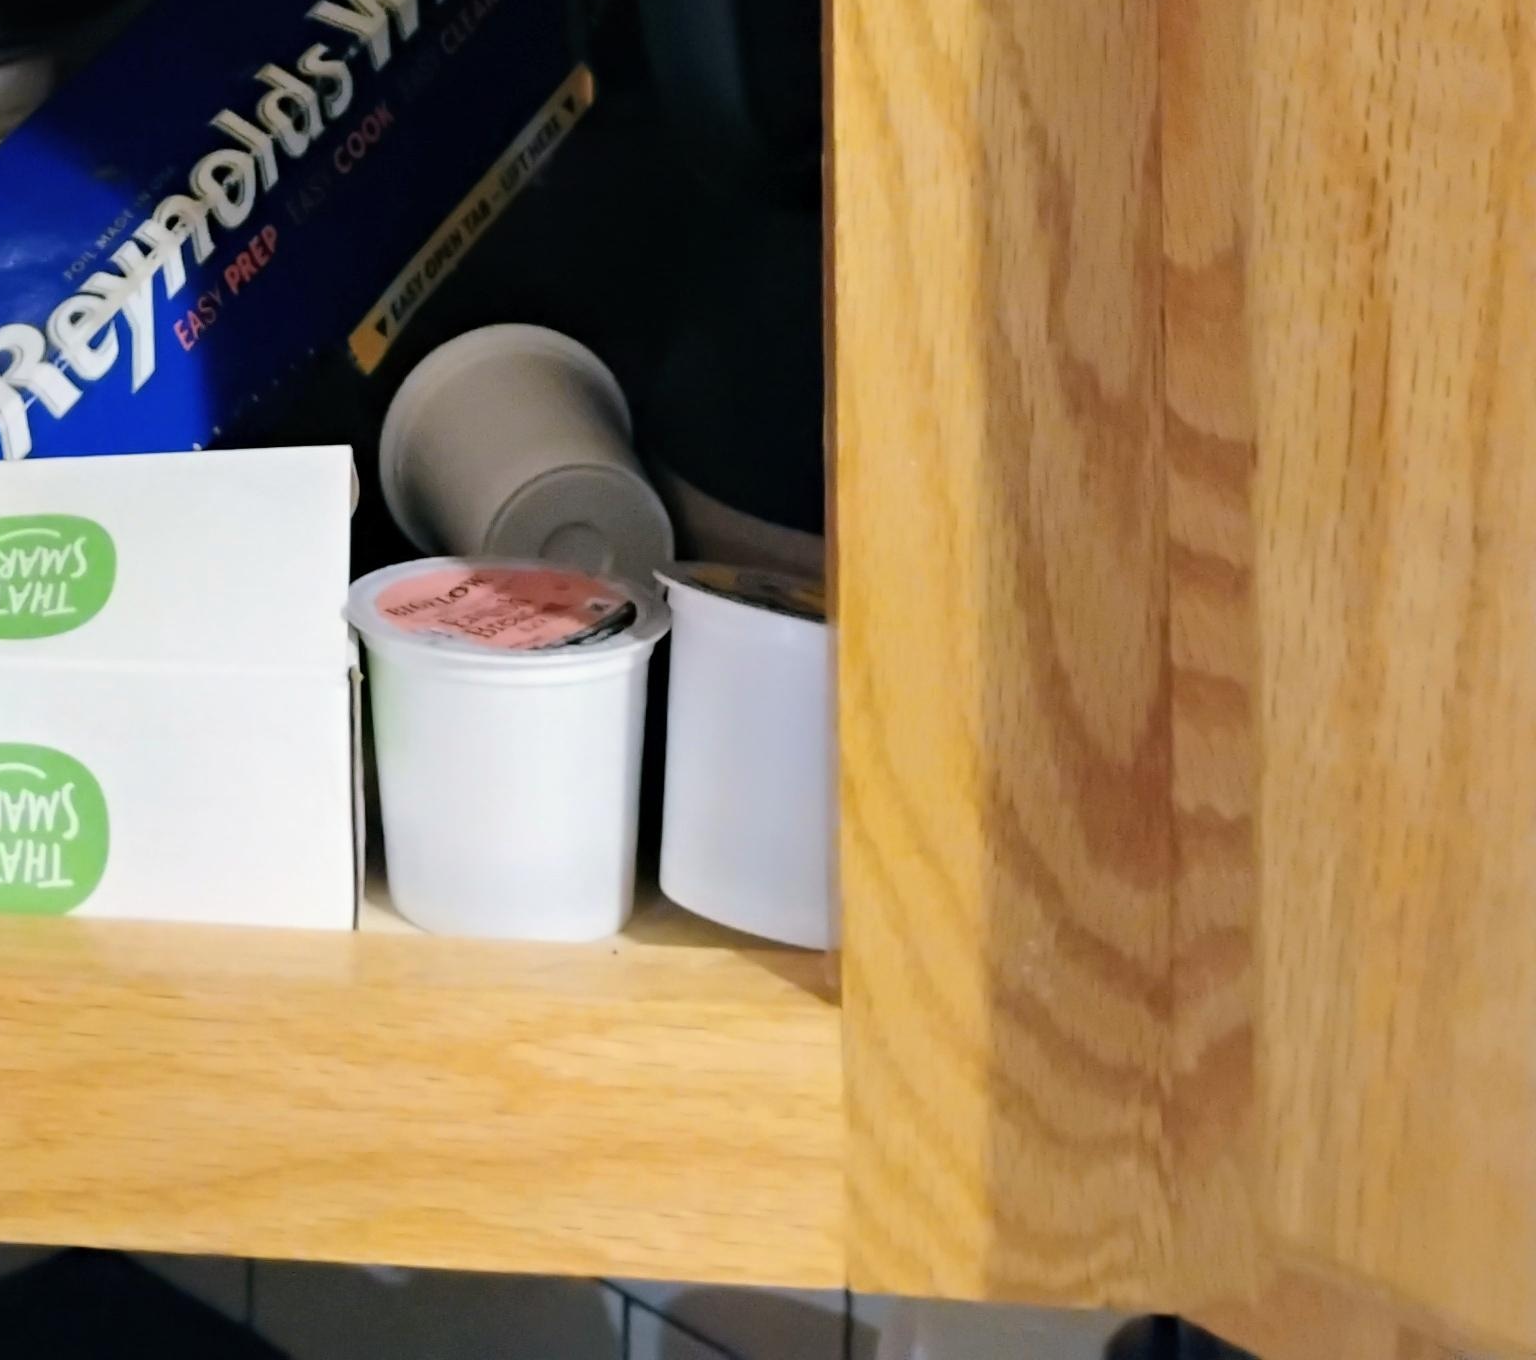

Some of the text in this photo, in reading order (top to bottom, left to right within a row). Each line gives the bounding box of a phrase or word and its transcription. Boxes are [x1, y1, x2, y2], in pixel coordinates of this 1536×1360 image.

[172, 287, 224, 352] EASY
[222, 223, 280, 296] PREP
[332, 98, 398, 176] COOK
[389, 271, 425, 322] EASY
[424, 229, 464, 280] OPEN
[462, 196, 492, 236] TAB
